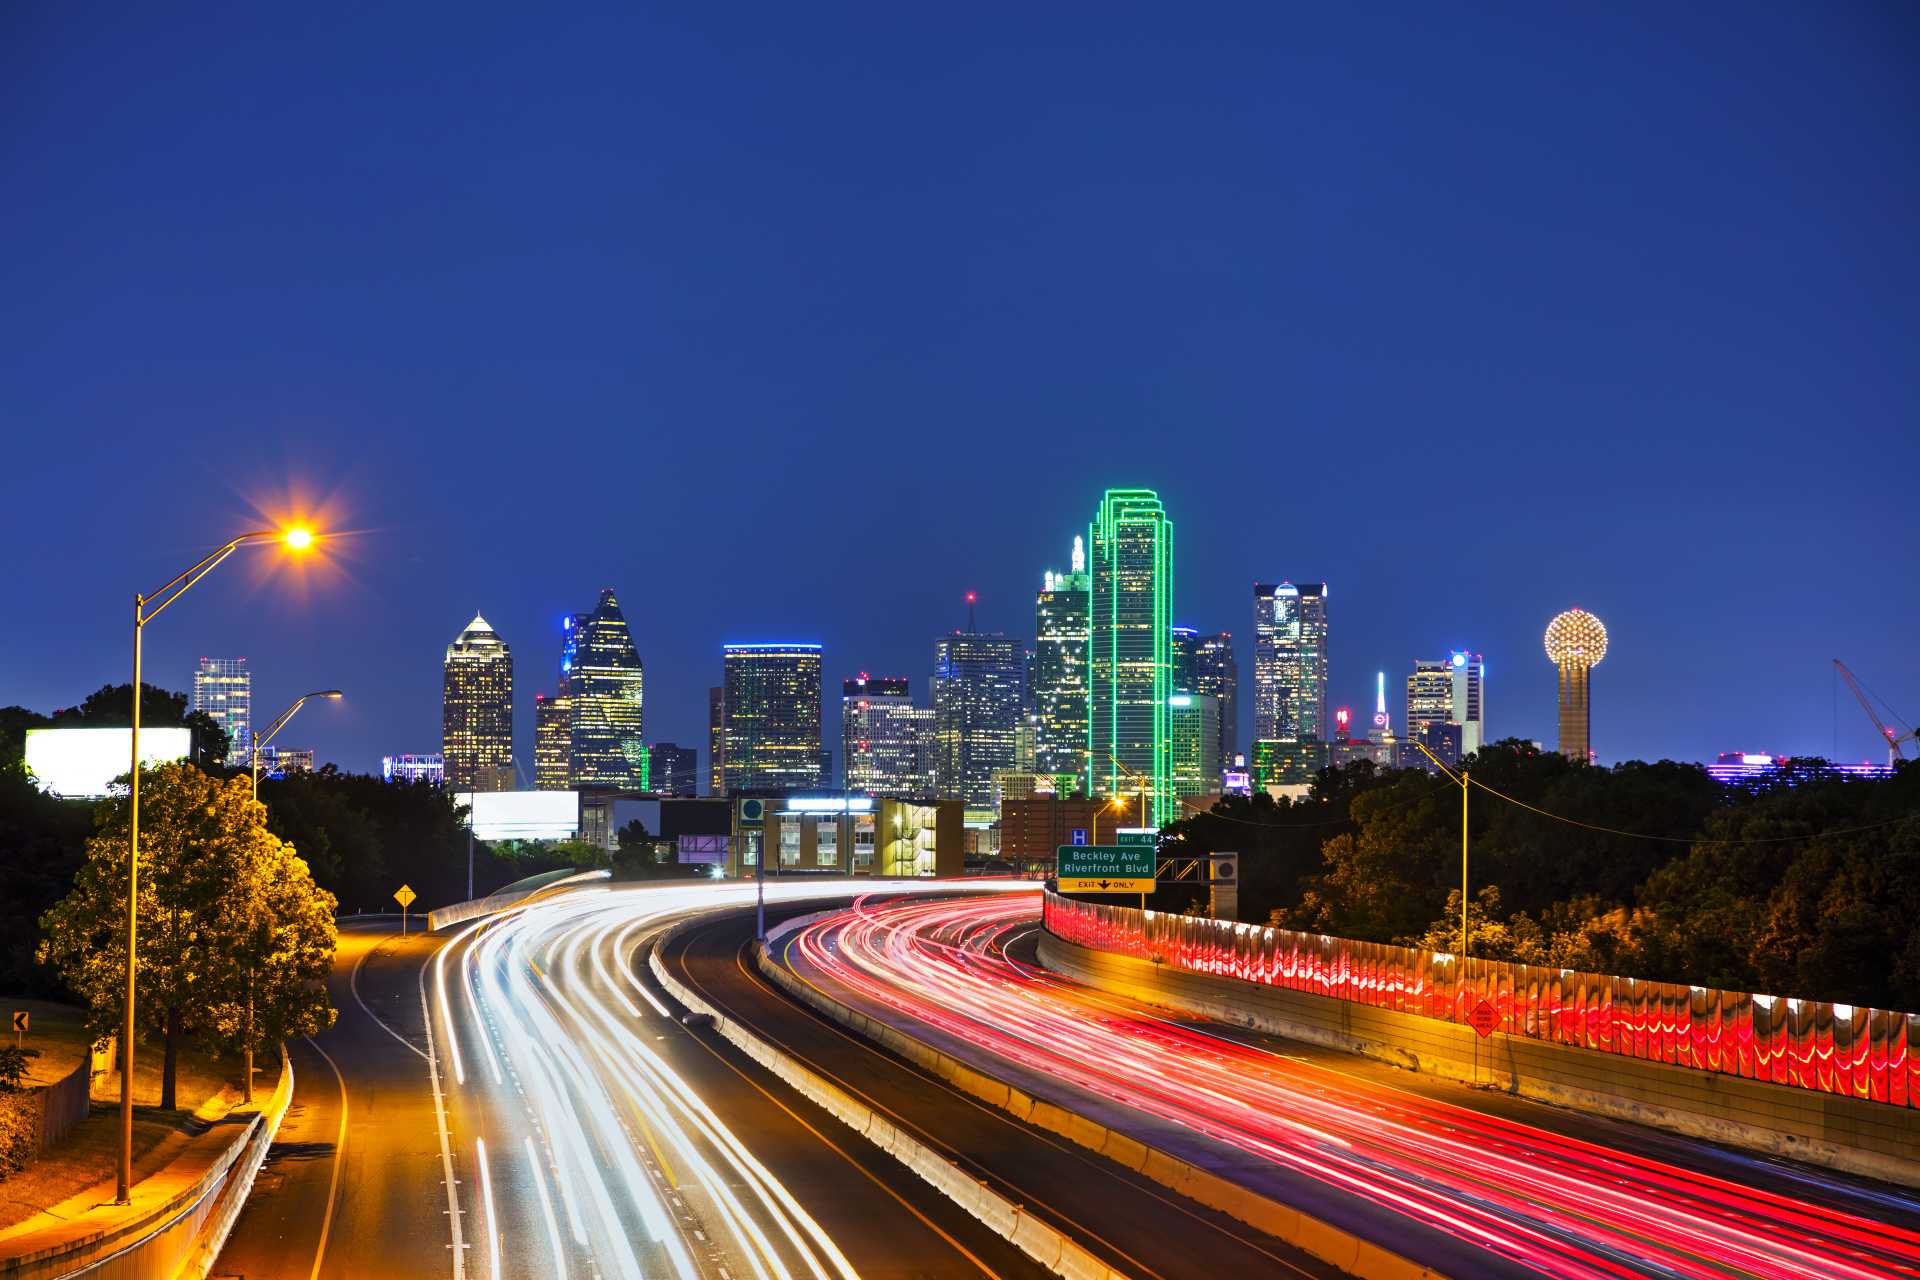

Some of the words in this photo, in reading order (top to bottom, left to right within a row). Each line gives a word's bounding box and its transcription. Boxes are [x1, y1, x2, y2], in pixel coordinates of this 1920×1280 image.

[1074, 831, 1085, 844] H
[1073, 852, 1116, 862] Beckley
[1121, 852, 1141, 860] Ave
[1064, 864, 1120, 872] Riverfront
[1125, 864, 1149, 872] Blvd
